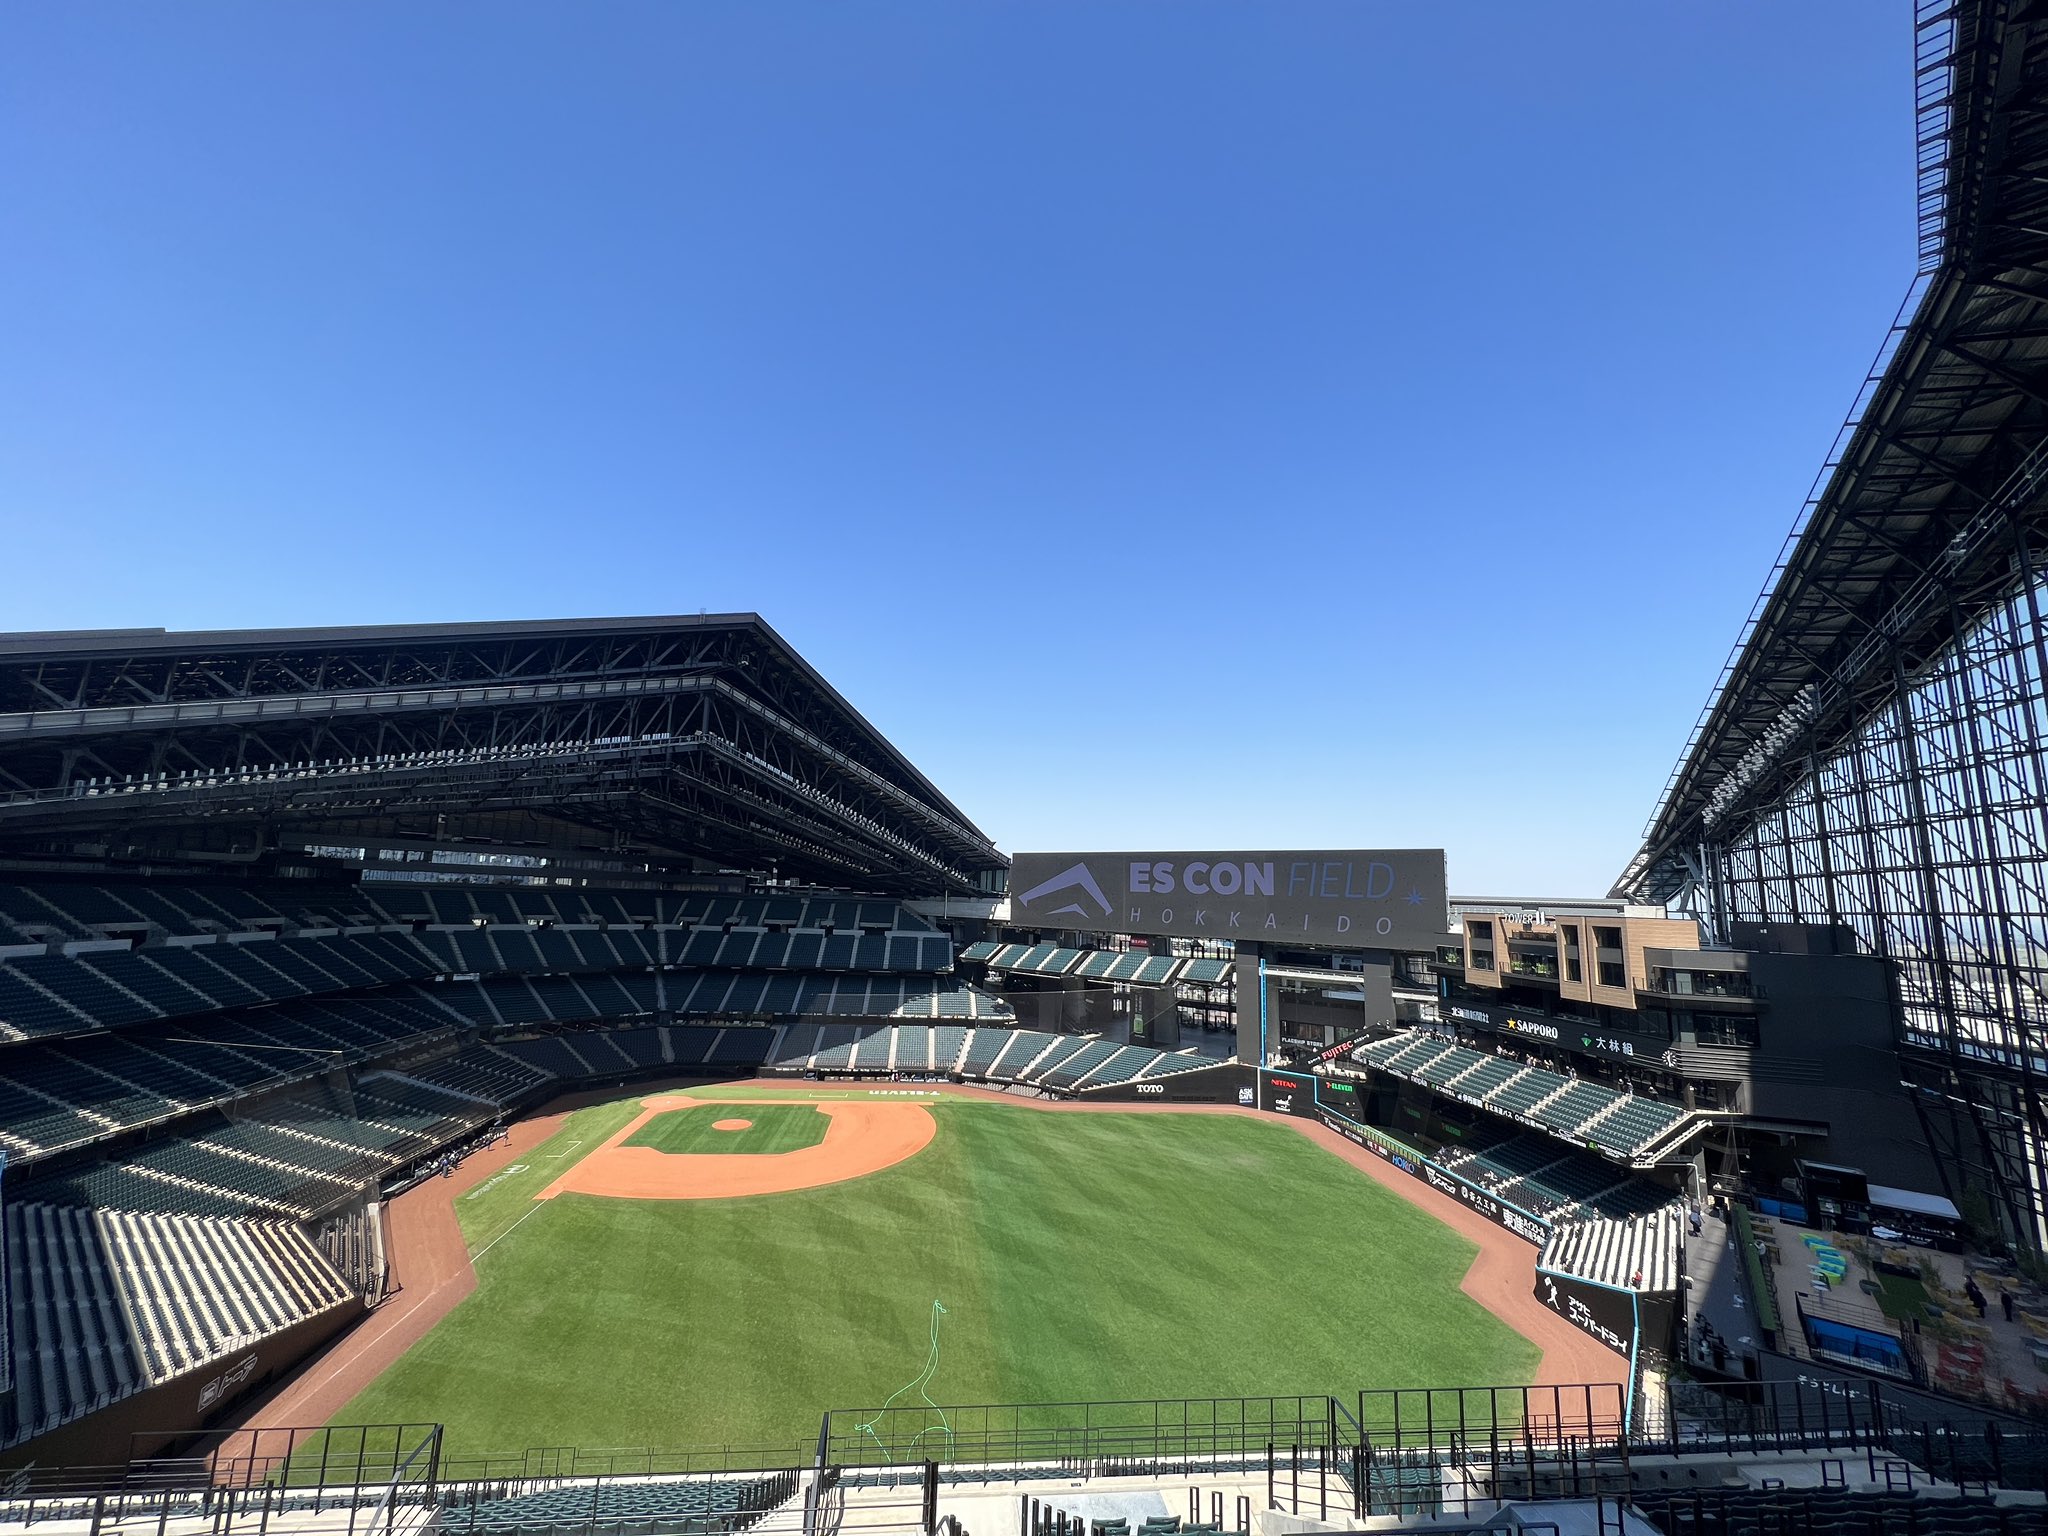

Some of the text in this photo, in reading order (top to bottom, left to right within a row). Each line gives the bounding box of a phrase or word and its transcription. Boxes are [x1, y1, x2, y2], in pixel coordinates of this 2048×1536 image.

[1288, 862, 1396, 899] FIELD
[1130, 907, 1392, 935] HOKKAIDO
[1504, 912, 1533, 924] TOWER
[1516, 1019, 1559, 1039] SAPPORO
[1282, 1037, 1324, 1048] FLAGSHIP STORE
[1321, 1040, 1354, 1060] FUJITEC
[1595, 1037, 1634, 1056] 大林組
[1136, 1084, 1164, 1093] TOTO
[1271, 1079, 1296, 1089] NITTAN
[1502, 1208, 1526, 1236] 東進
[1567, 1295, 1592, 1317] アサヒ
[1569, 1306, 1628, 1353] スーパードライ
